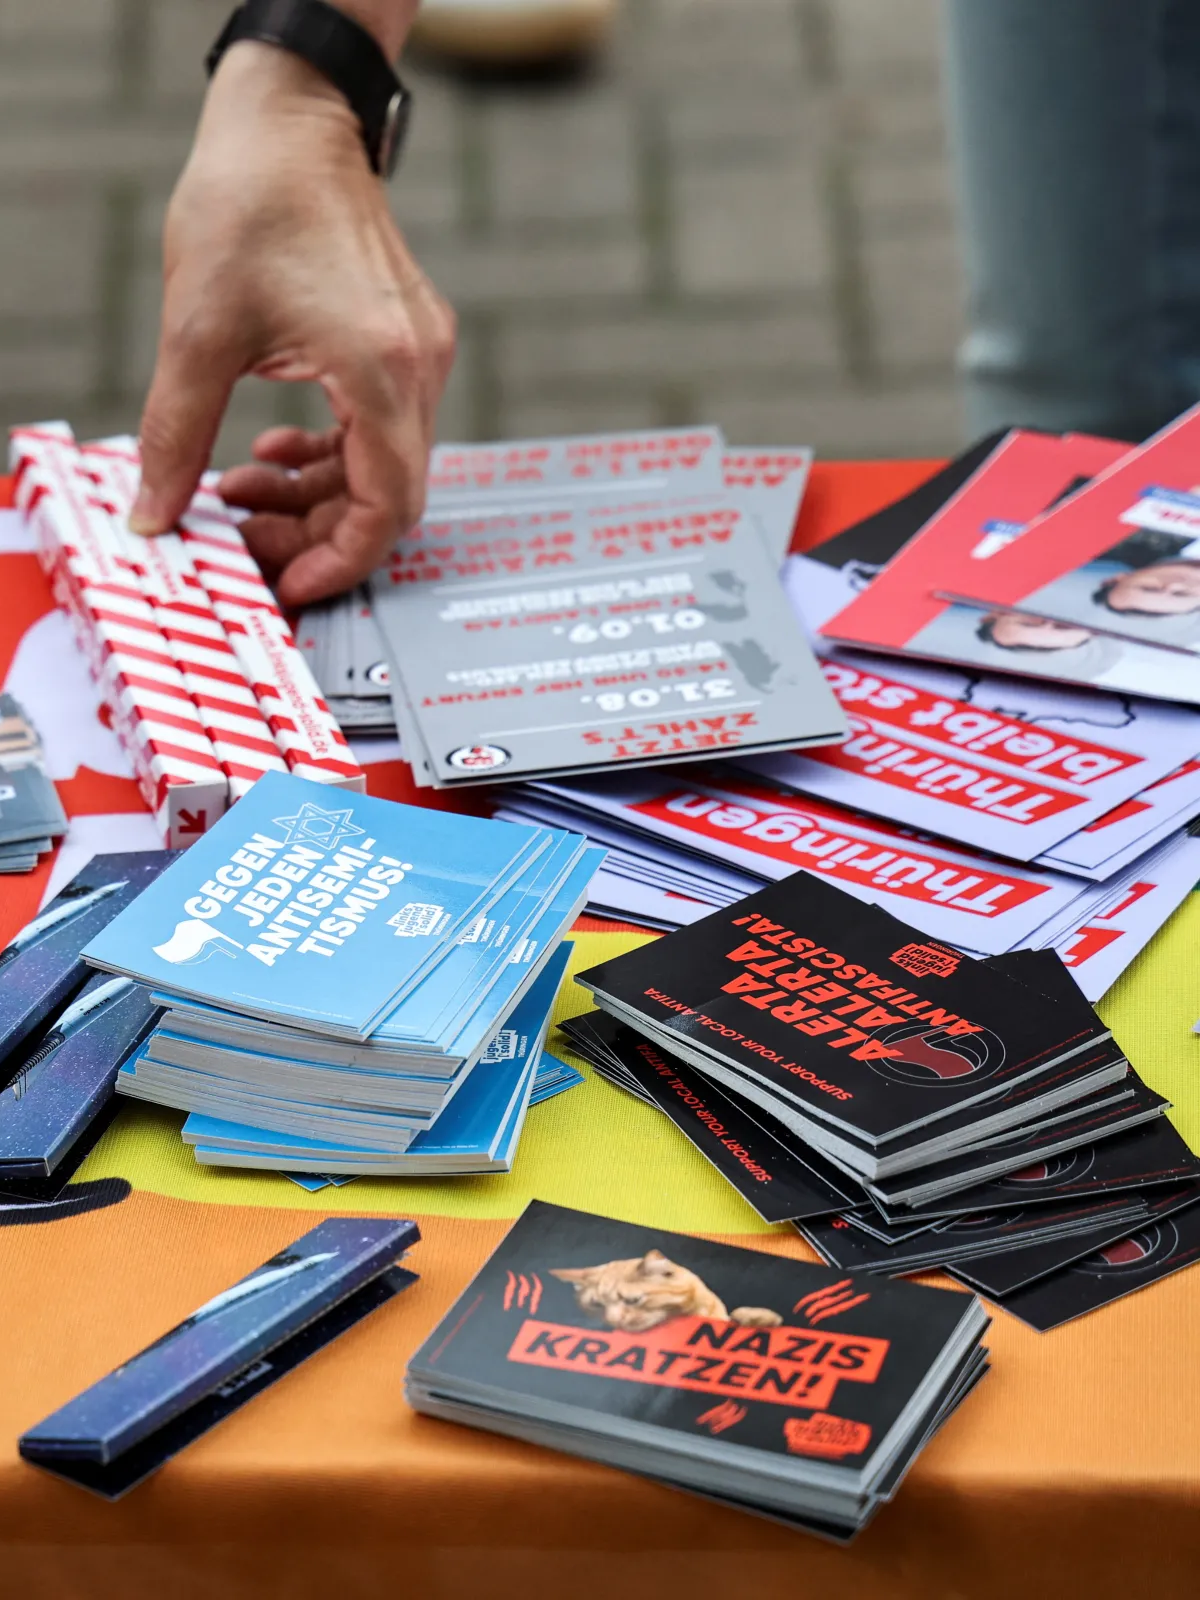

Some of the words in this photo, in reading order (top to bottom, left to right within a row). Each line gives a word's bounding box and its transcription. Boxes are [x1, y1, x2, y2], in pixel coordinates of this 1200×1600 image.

[553, 608, 706, 645] 01.09.
[421, 687, 524, 707] ERFURT
[580, 677, 737, 712] 31.08.
[593, 672, 647, 687] UHR
[581, 711, 758, 745] ZÄHLT'S
[612, 731, 743, 758] JETZT
[910, 701, 1121, 783] bleibt
[664, 795, 1015, 914] Thüringen
[183, 832, 287, 920] GEGEN
[232, 844, 325, 927] JEDEN
[243, 837, 377, 967] ANTISEMI-
[297, 857, 414, 959] TISMUS!
[394, 907, 413, 926] links
[404, 905, 424, 934] jugend
[897, 953, 951, 974] jugend
[897, 958, 931, 974] links
[927, 942, 966, 959] THÜRINGEN
[725, 940, 909, 1029] ALERTA
[731, 913, 985, 1037] ANTIFASCISTA!
[643, 987, 697, 1016] ANTIFA
[720, 972, 905, 1061] ALERTA
[696, 1014, 745, 1041] LOCAL
[634, 1043, 674, 1078] ANTIFA
[740, 1039, 785, 1065] YOUR
[668, 1078, 705, 1110] LOCAL
[779, 1060, 854, 1101] SUPPORT
[696, 1104, 729, 1137] YOUR
[721, 1138, 772, 1182] SUPPORT
[526, 1330, 829, 1397] KRATZEN!
[686, 1322, 871, 1370] NAZIS
